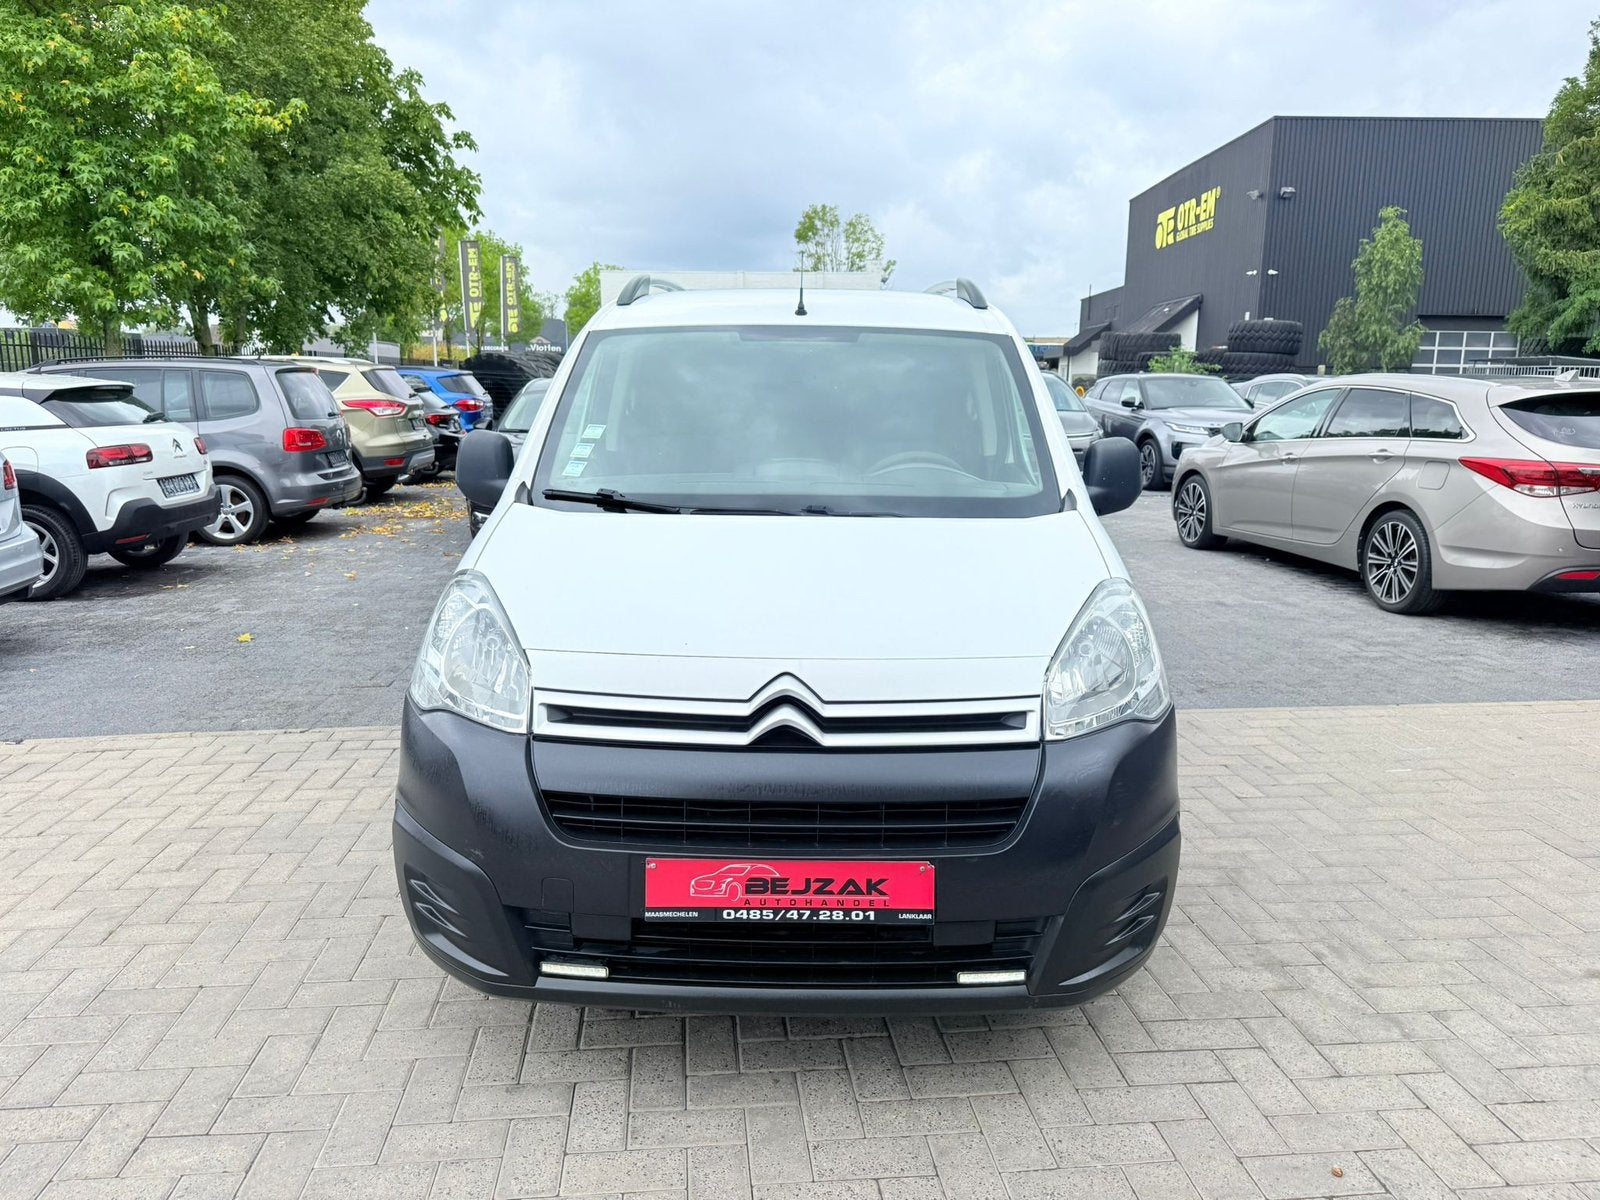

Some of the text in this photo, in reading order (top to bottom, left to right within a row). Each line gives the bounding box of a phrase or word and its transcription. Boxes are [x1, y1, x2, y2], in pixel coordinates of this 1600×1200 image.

[1176, 187, 1218, 231] OTR-EM
[744, 877, 890, 896] BEJZAK
[743, 898, 890, 907] AUTOHANDEL
[722, 909, 875, 921] 0485/47.28.01
